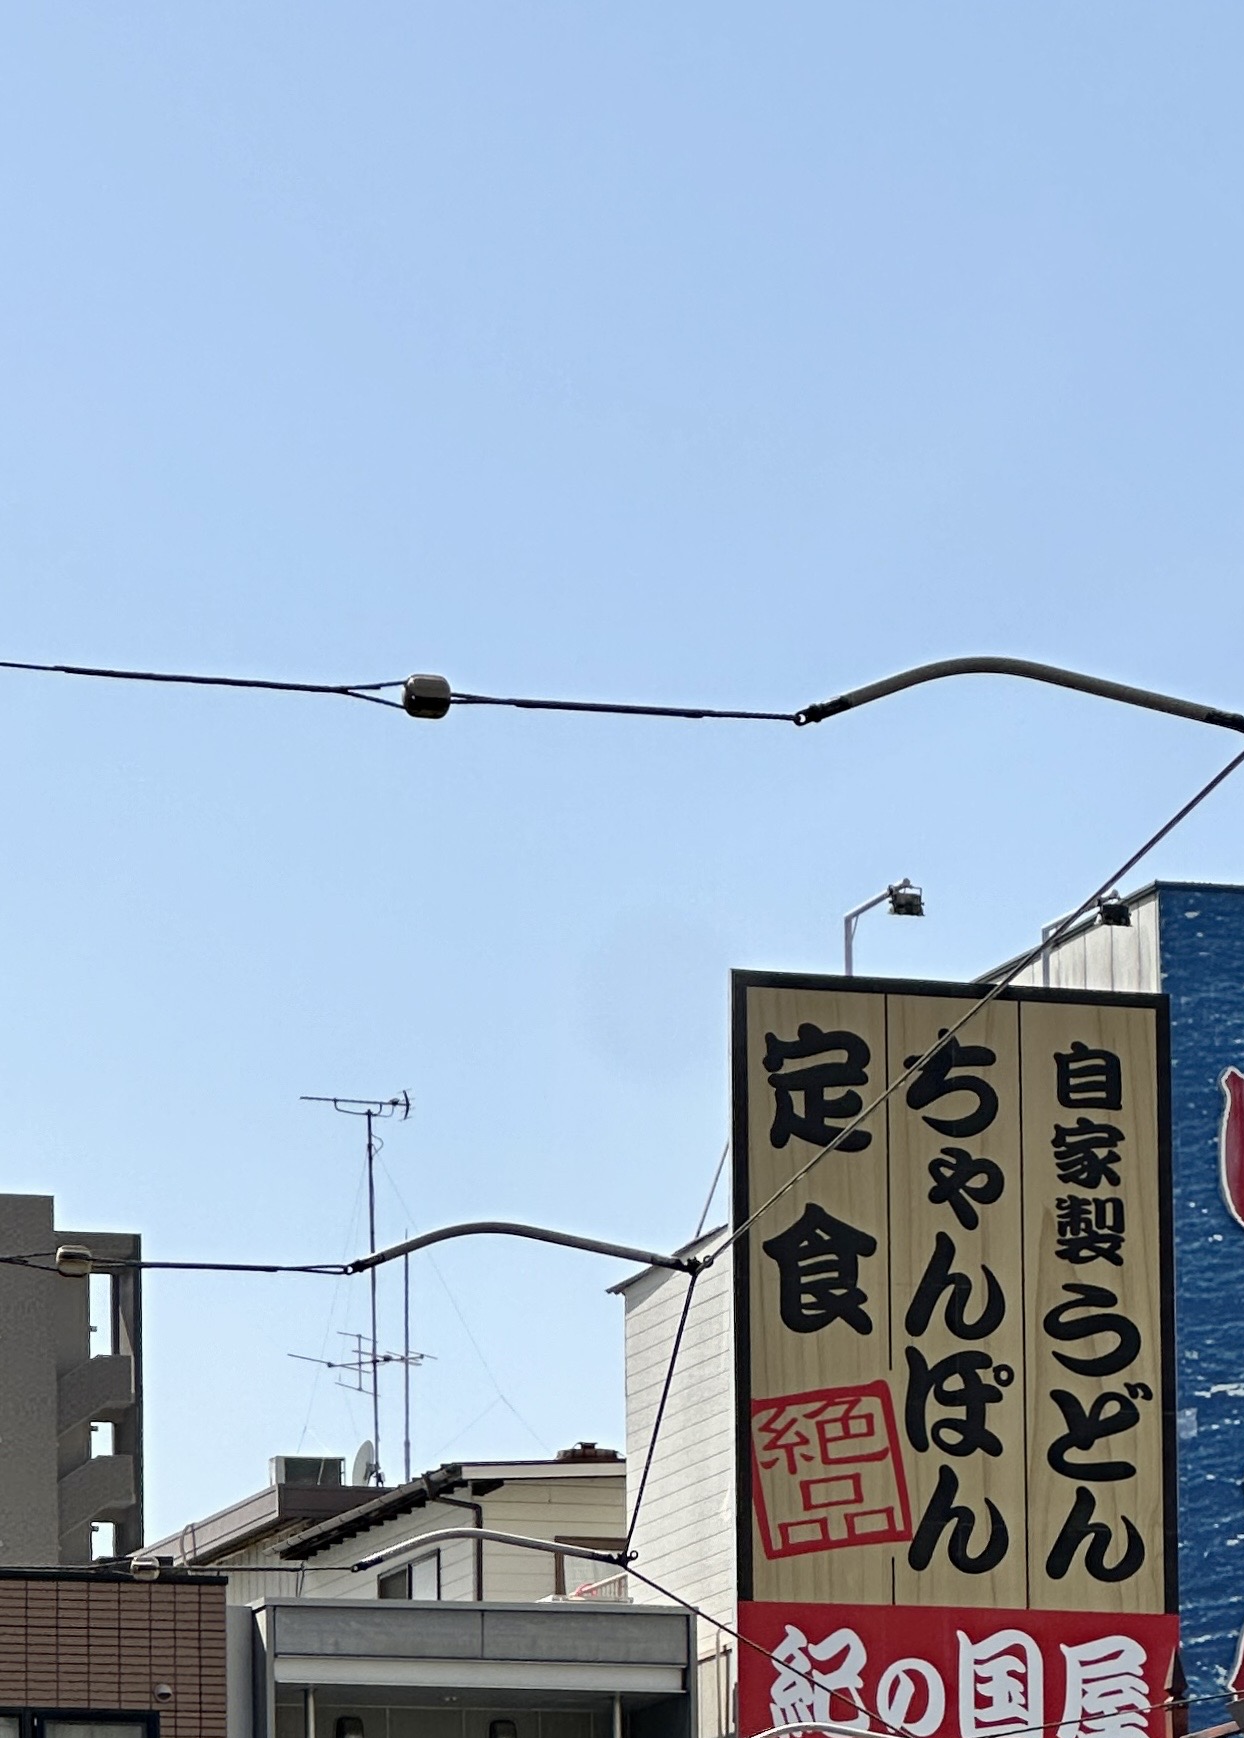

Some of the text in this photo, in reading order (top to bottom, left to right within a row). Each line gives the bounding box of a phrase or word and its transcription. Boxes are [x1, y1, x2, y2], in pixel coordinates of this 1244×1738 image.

[762, 1023, 877, 1336] 定食
[903, 1028, 1016, 1576] ちゃんぽん
[1043, 1041, 1153, 1584] 自家製うどん
[757, 1398, 896, 1546] 絶品
